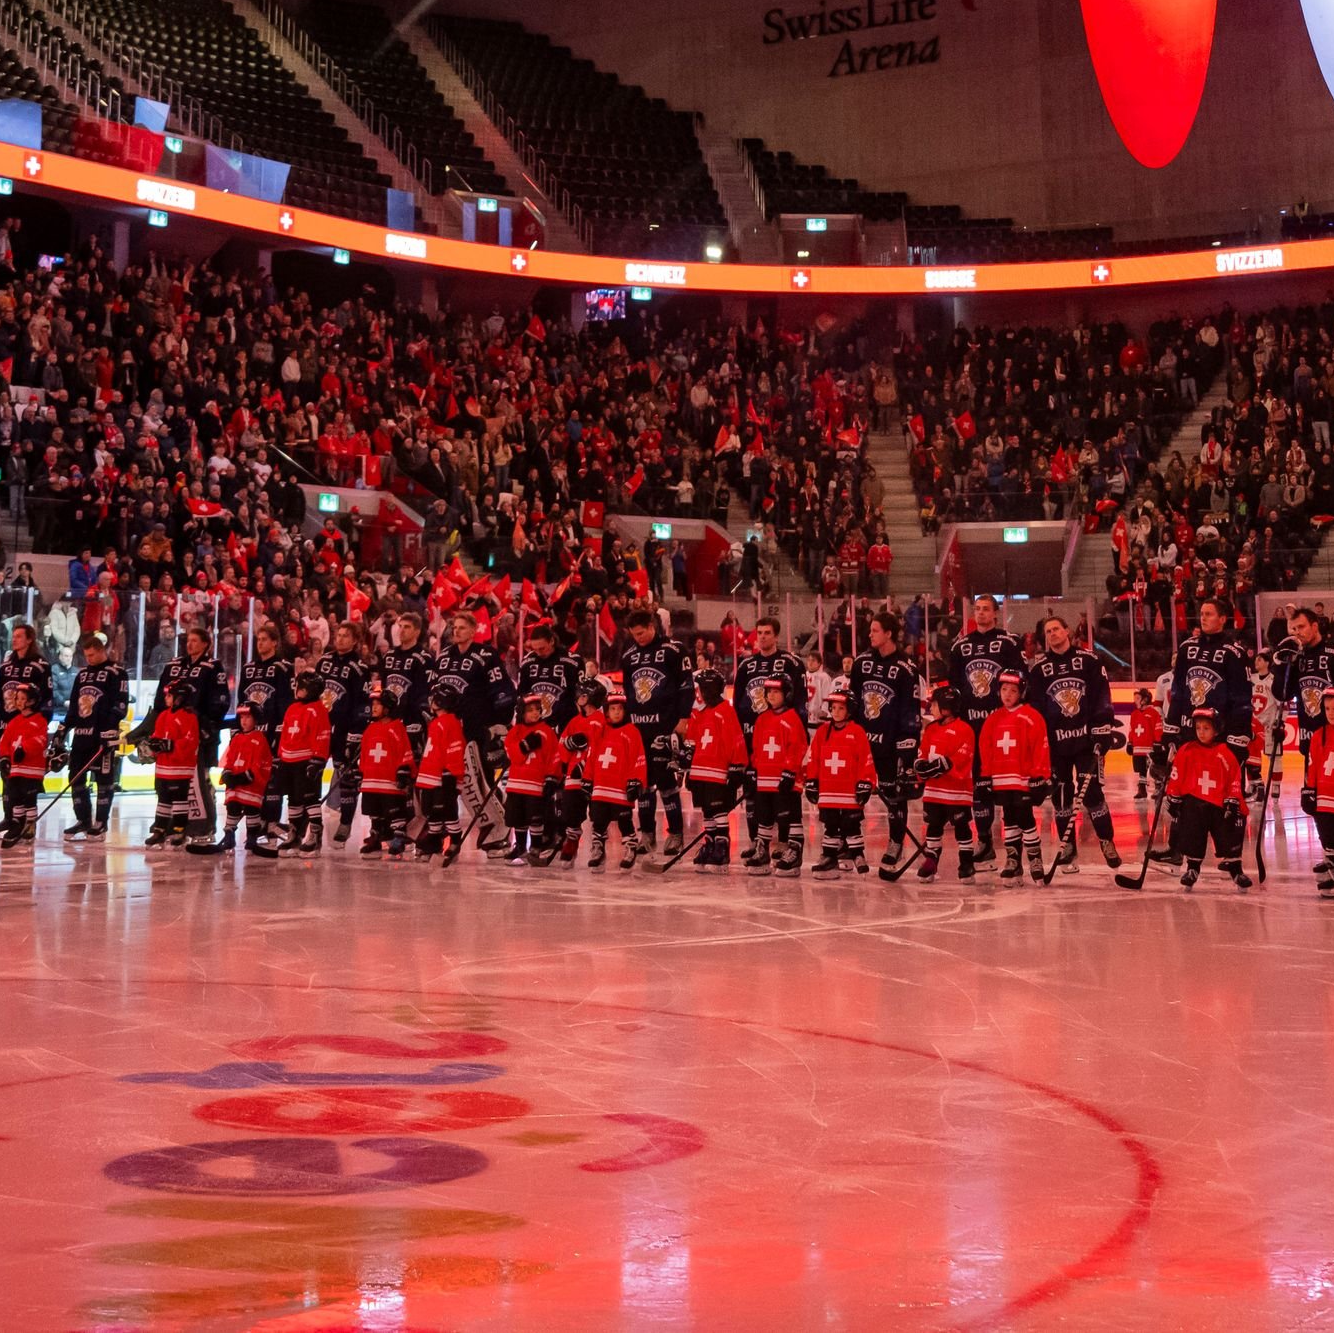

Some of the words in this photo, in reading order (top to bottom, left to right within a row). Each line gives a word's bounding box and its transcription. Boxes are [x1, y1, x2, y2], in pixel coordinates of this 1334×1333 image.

[828, 33, 941, 78] Arena
[1215, 249, 1284, 272] SVIZZERA
[625, 263, 686, 284] SCHWEIZ
[404, 532, 422, 549] F1
[767, 606, 779, 616] E2
[967, 661, 994, 672] SUOMI
[487, 667, 502, 682] 35
[1188, 669, 1215, 680] SUOMI
[863, 683, 888, 696] SUOMI
[1051, 680, 1081, 692] SUOMI
[1227, 737, 1250, 745] CCM
